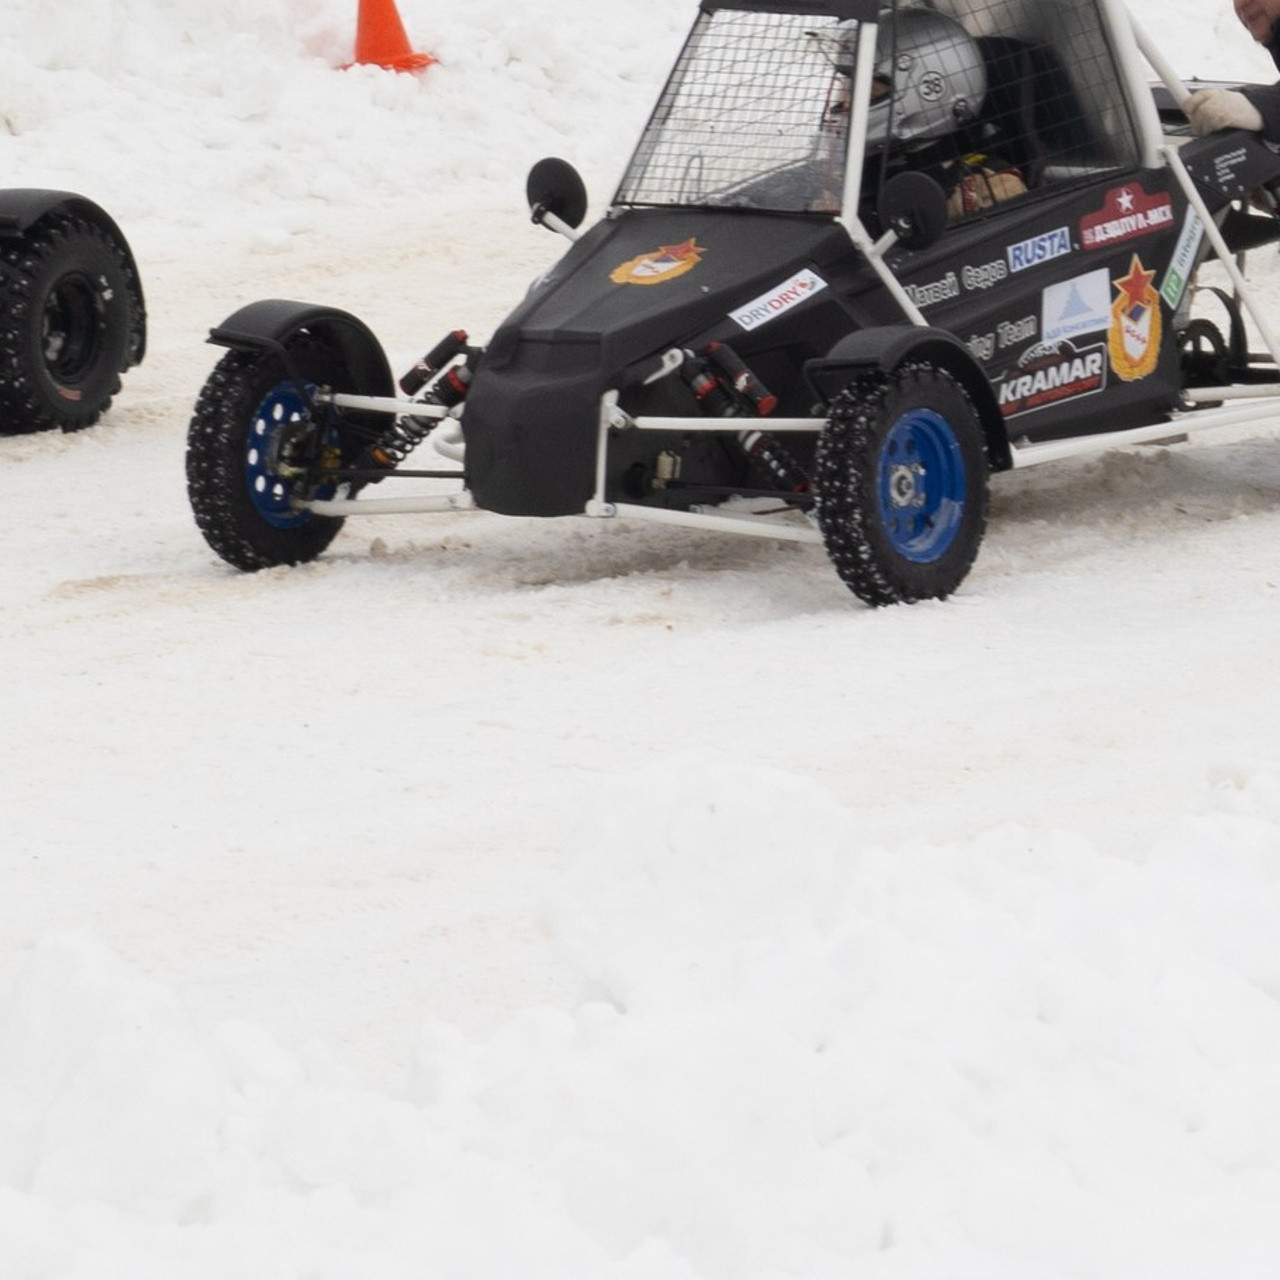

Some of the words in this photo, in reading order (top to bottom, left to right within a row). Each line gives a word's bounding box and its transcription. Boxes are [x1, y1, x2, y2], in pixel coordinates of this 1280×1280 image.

[1010, 231, 1071, 271] RUSTA
[738, 285, 801, 326] DRYDRY
[997, 315, 1038, 348] Team
[999, 352, 1102, 405] KRAMAR
